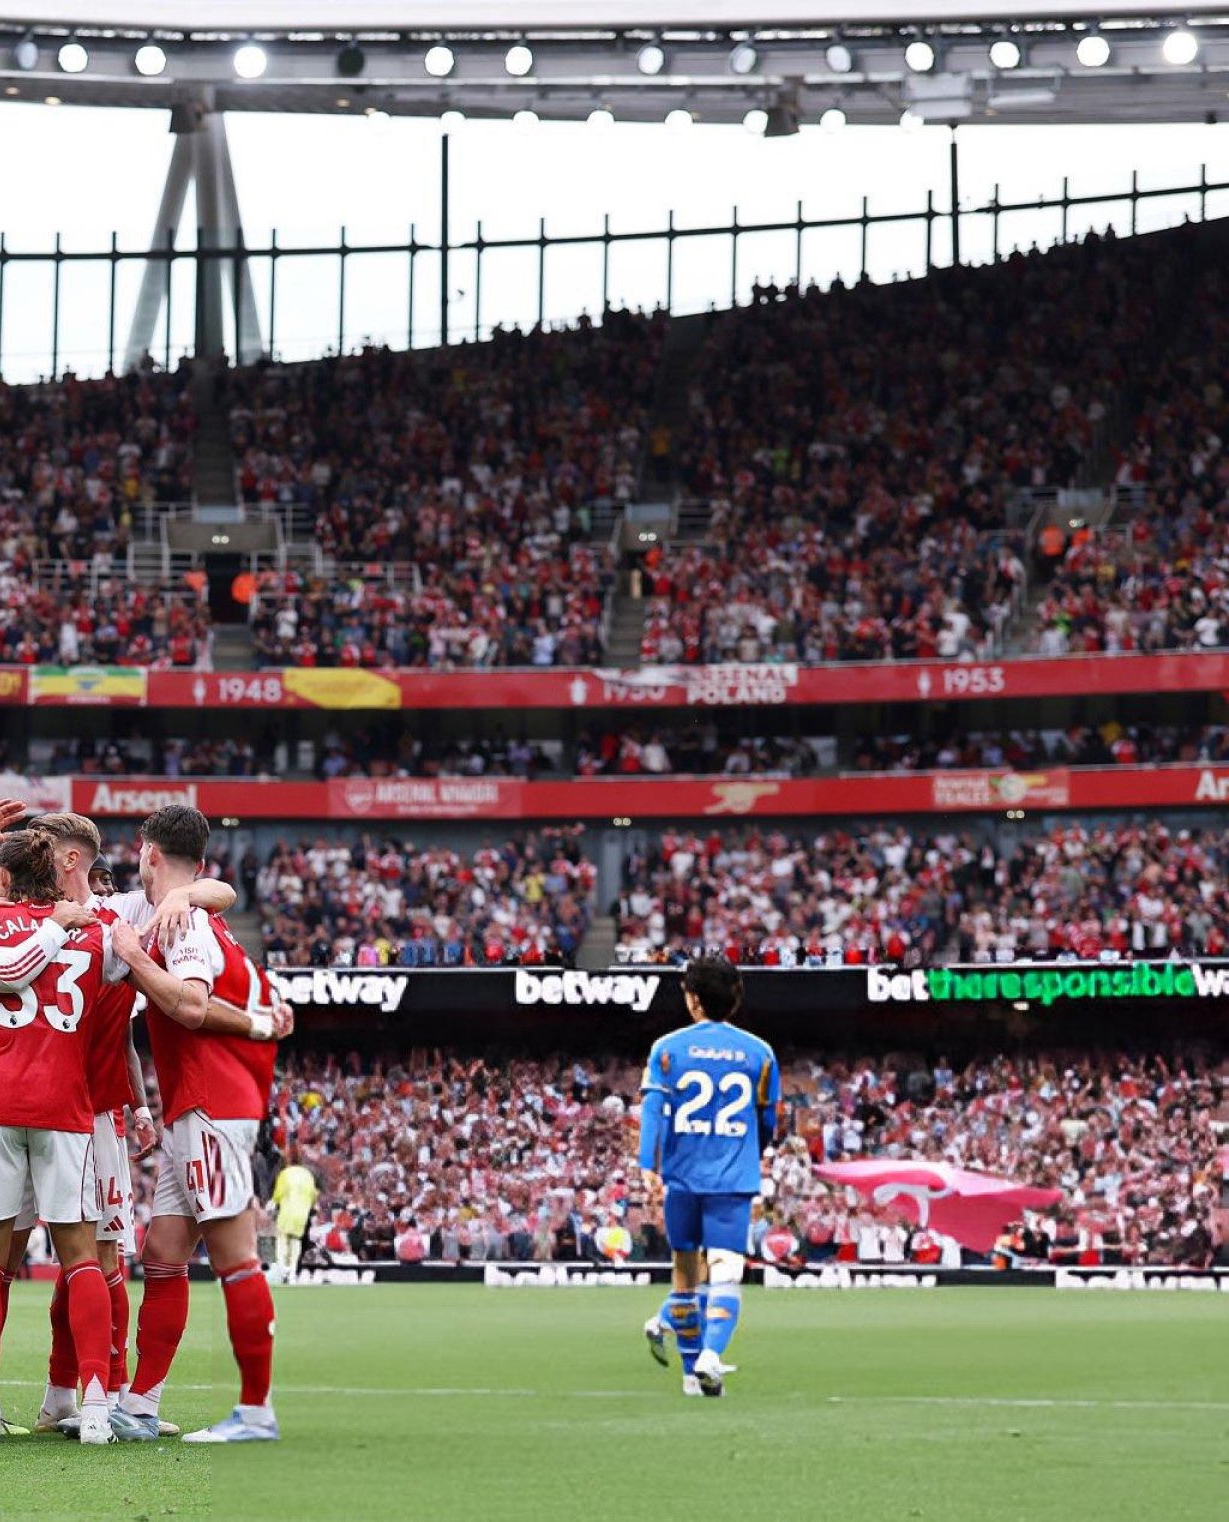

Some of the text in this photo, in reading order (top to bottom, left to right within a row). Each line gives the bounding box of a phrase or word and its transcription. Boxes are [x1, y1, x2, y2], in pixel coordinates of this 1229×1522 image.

[219, 678, 282, 702] 1948
[943, 667, 1006, 693] 1953
[92, 784, 197, 812] Arsenal
[516, 971, 659, 1010] betway
[674, 1069, 752, 1137] 22
